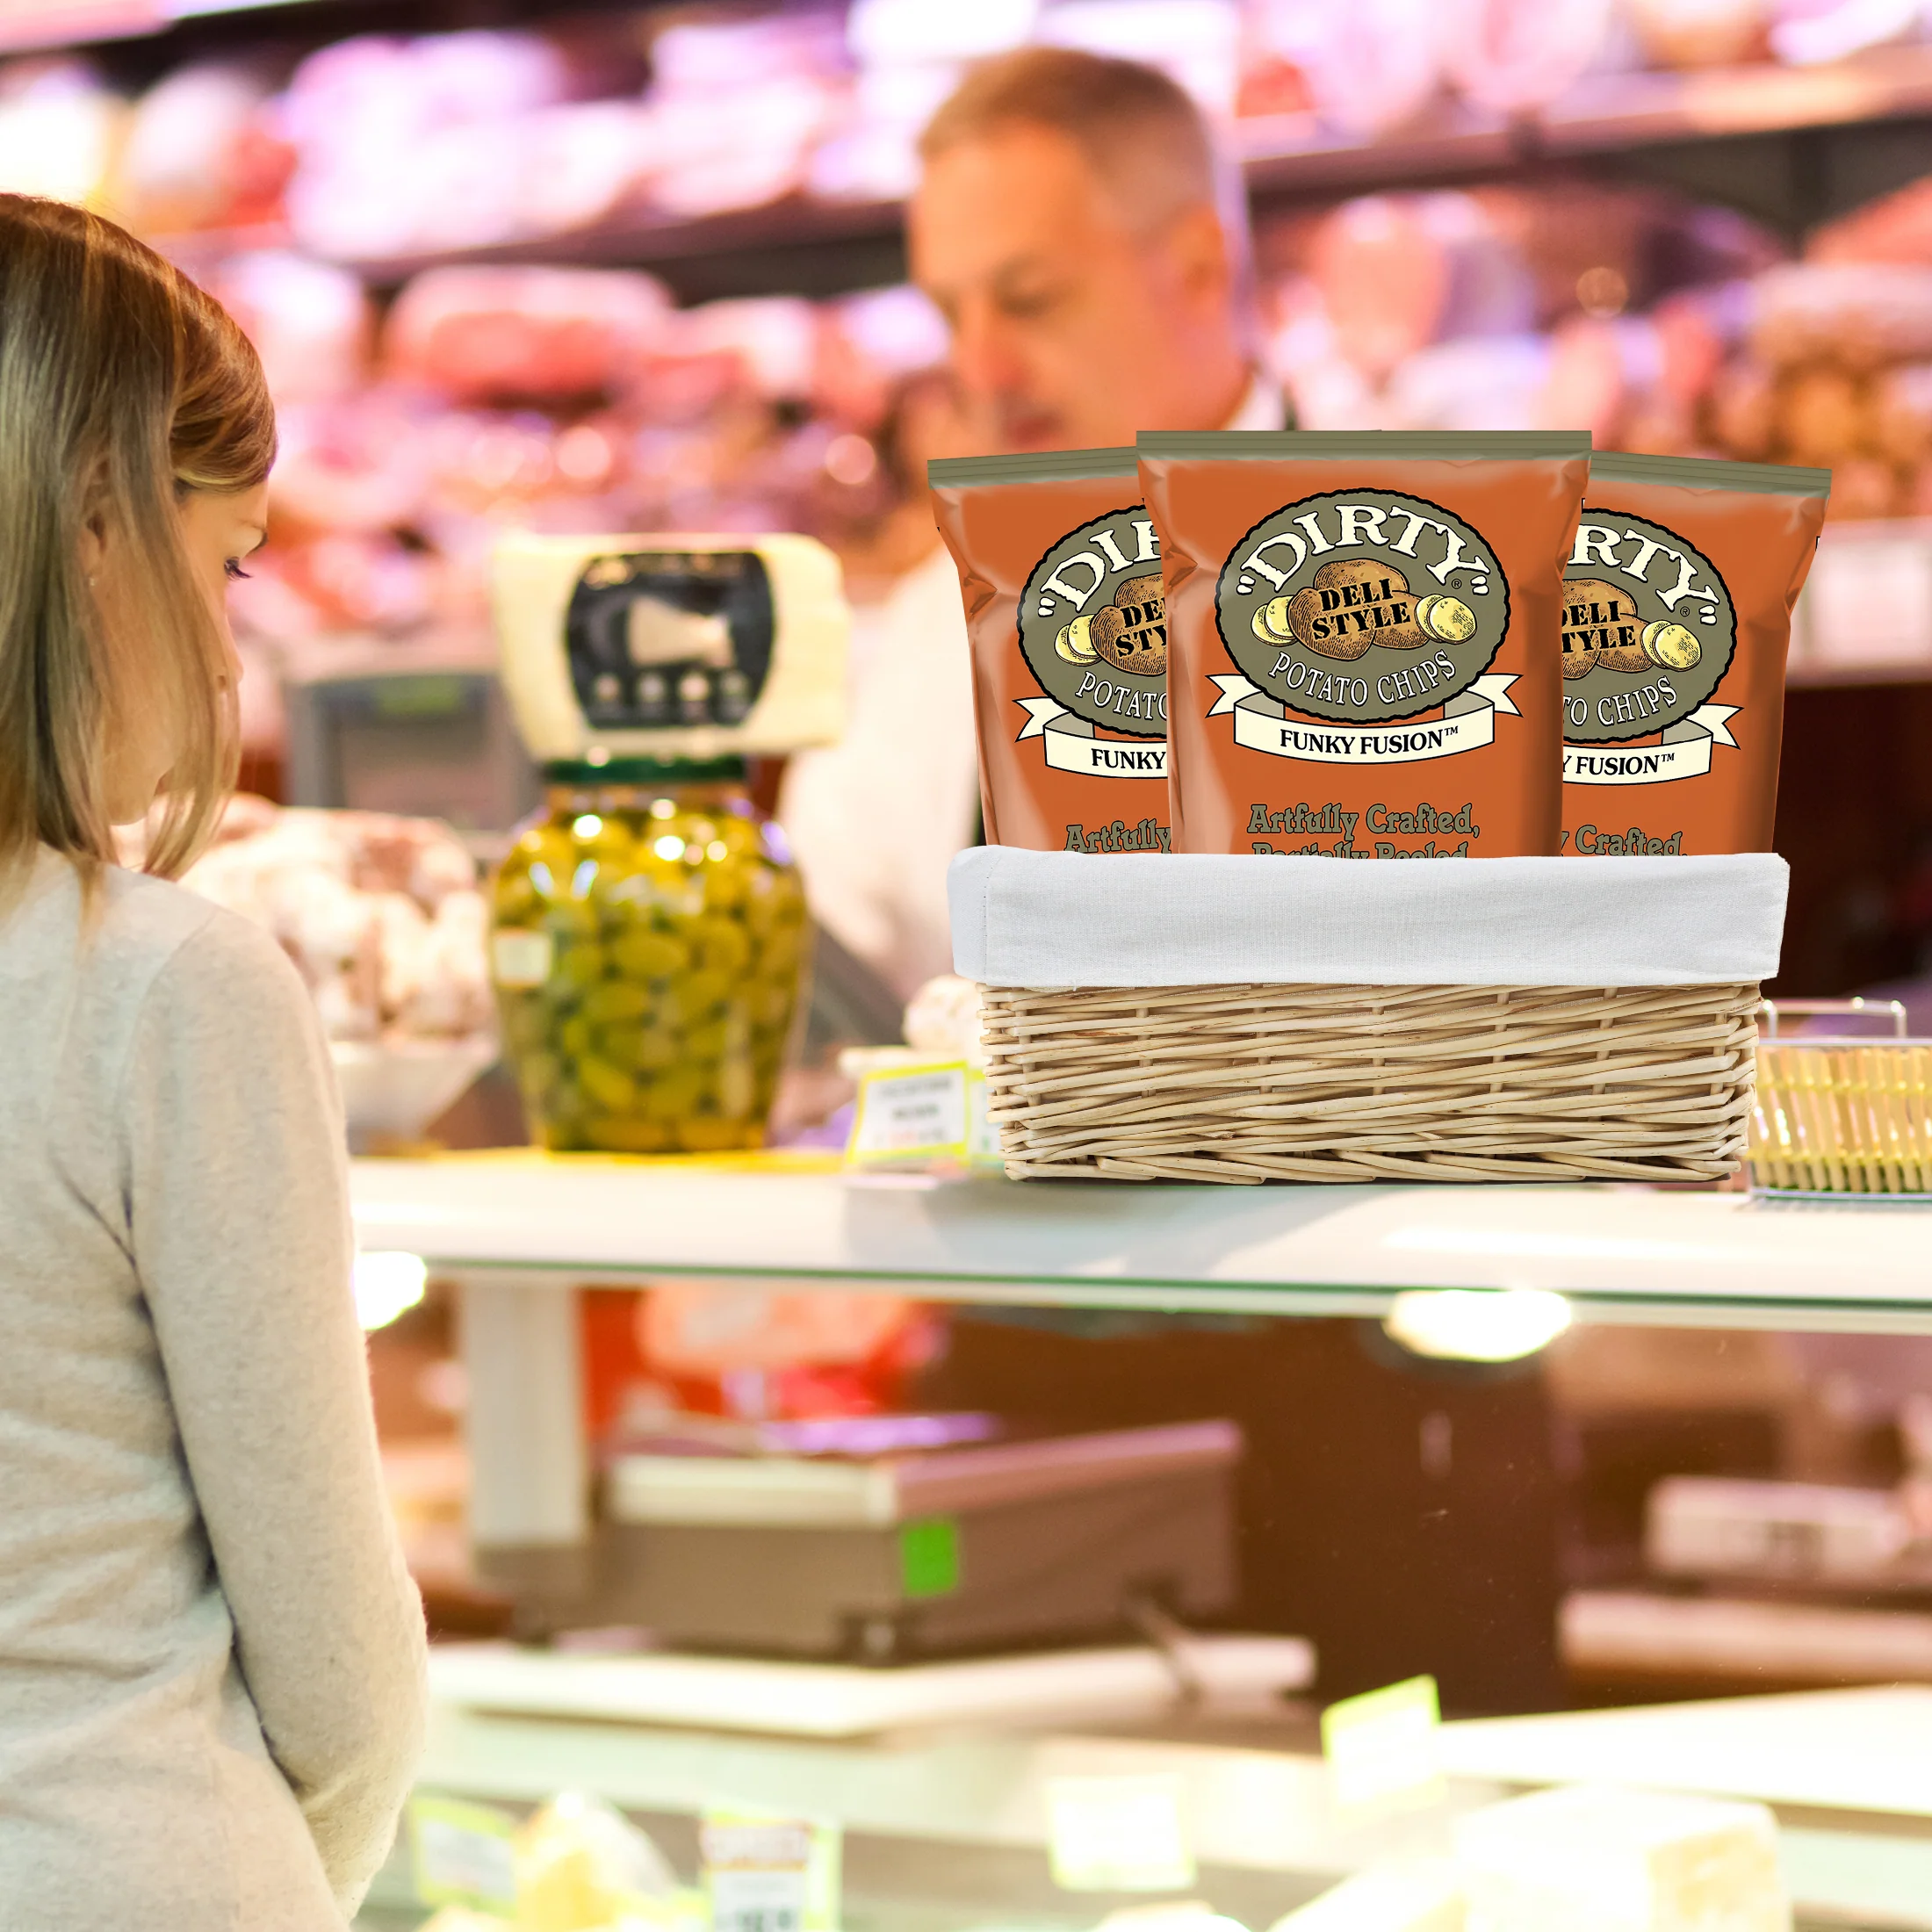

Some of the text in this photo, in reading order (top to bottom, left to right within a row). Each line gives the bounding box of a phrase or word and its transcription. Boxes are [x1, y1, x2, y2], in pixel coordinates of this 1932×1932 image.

[1318, 578, 1394, 612] DELI
[1311, 602, 1411, 640] STYLE
[1561, 600, 1621, 627] ELI
[1267, 649, 1456, 706] POTATO CHIPS
[1597, 675, 1677, 727] CHIPS
[1091, 747, 1167, 770] FUNKY
[1280, 729, 1356, 754] FUNKY
[1246, 802, 1481, 841] Artfully Crafted,
[1575, 824, 1688, 856] Crafted
